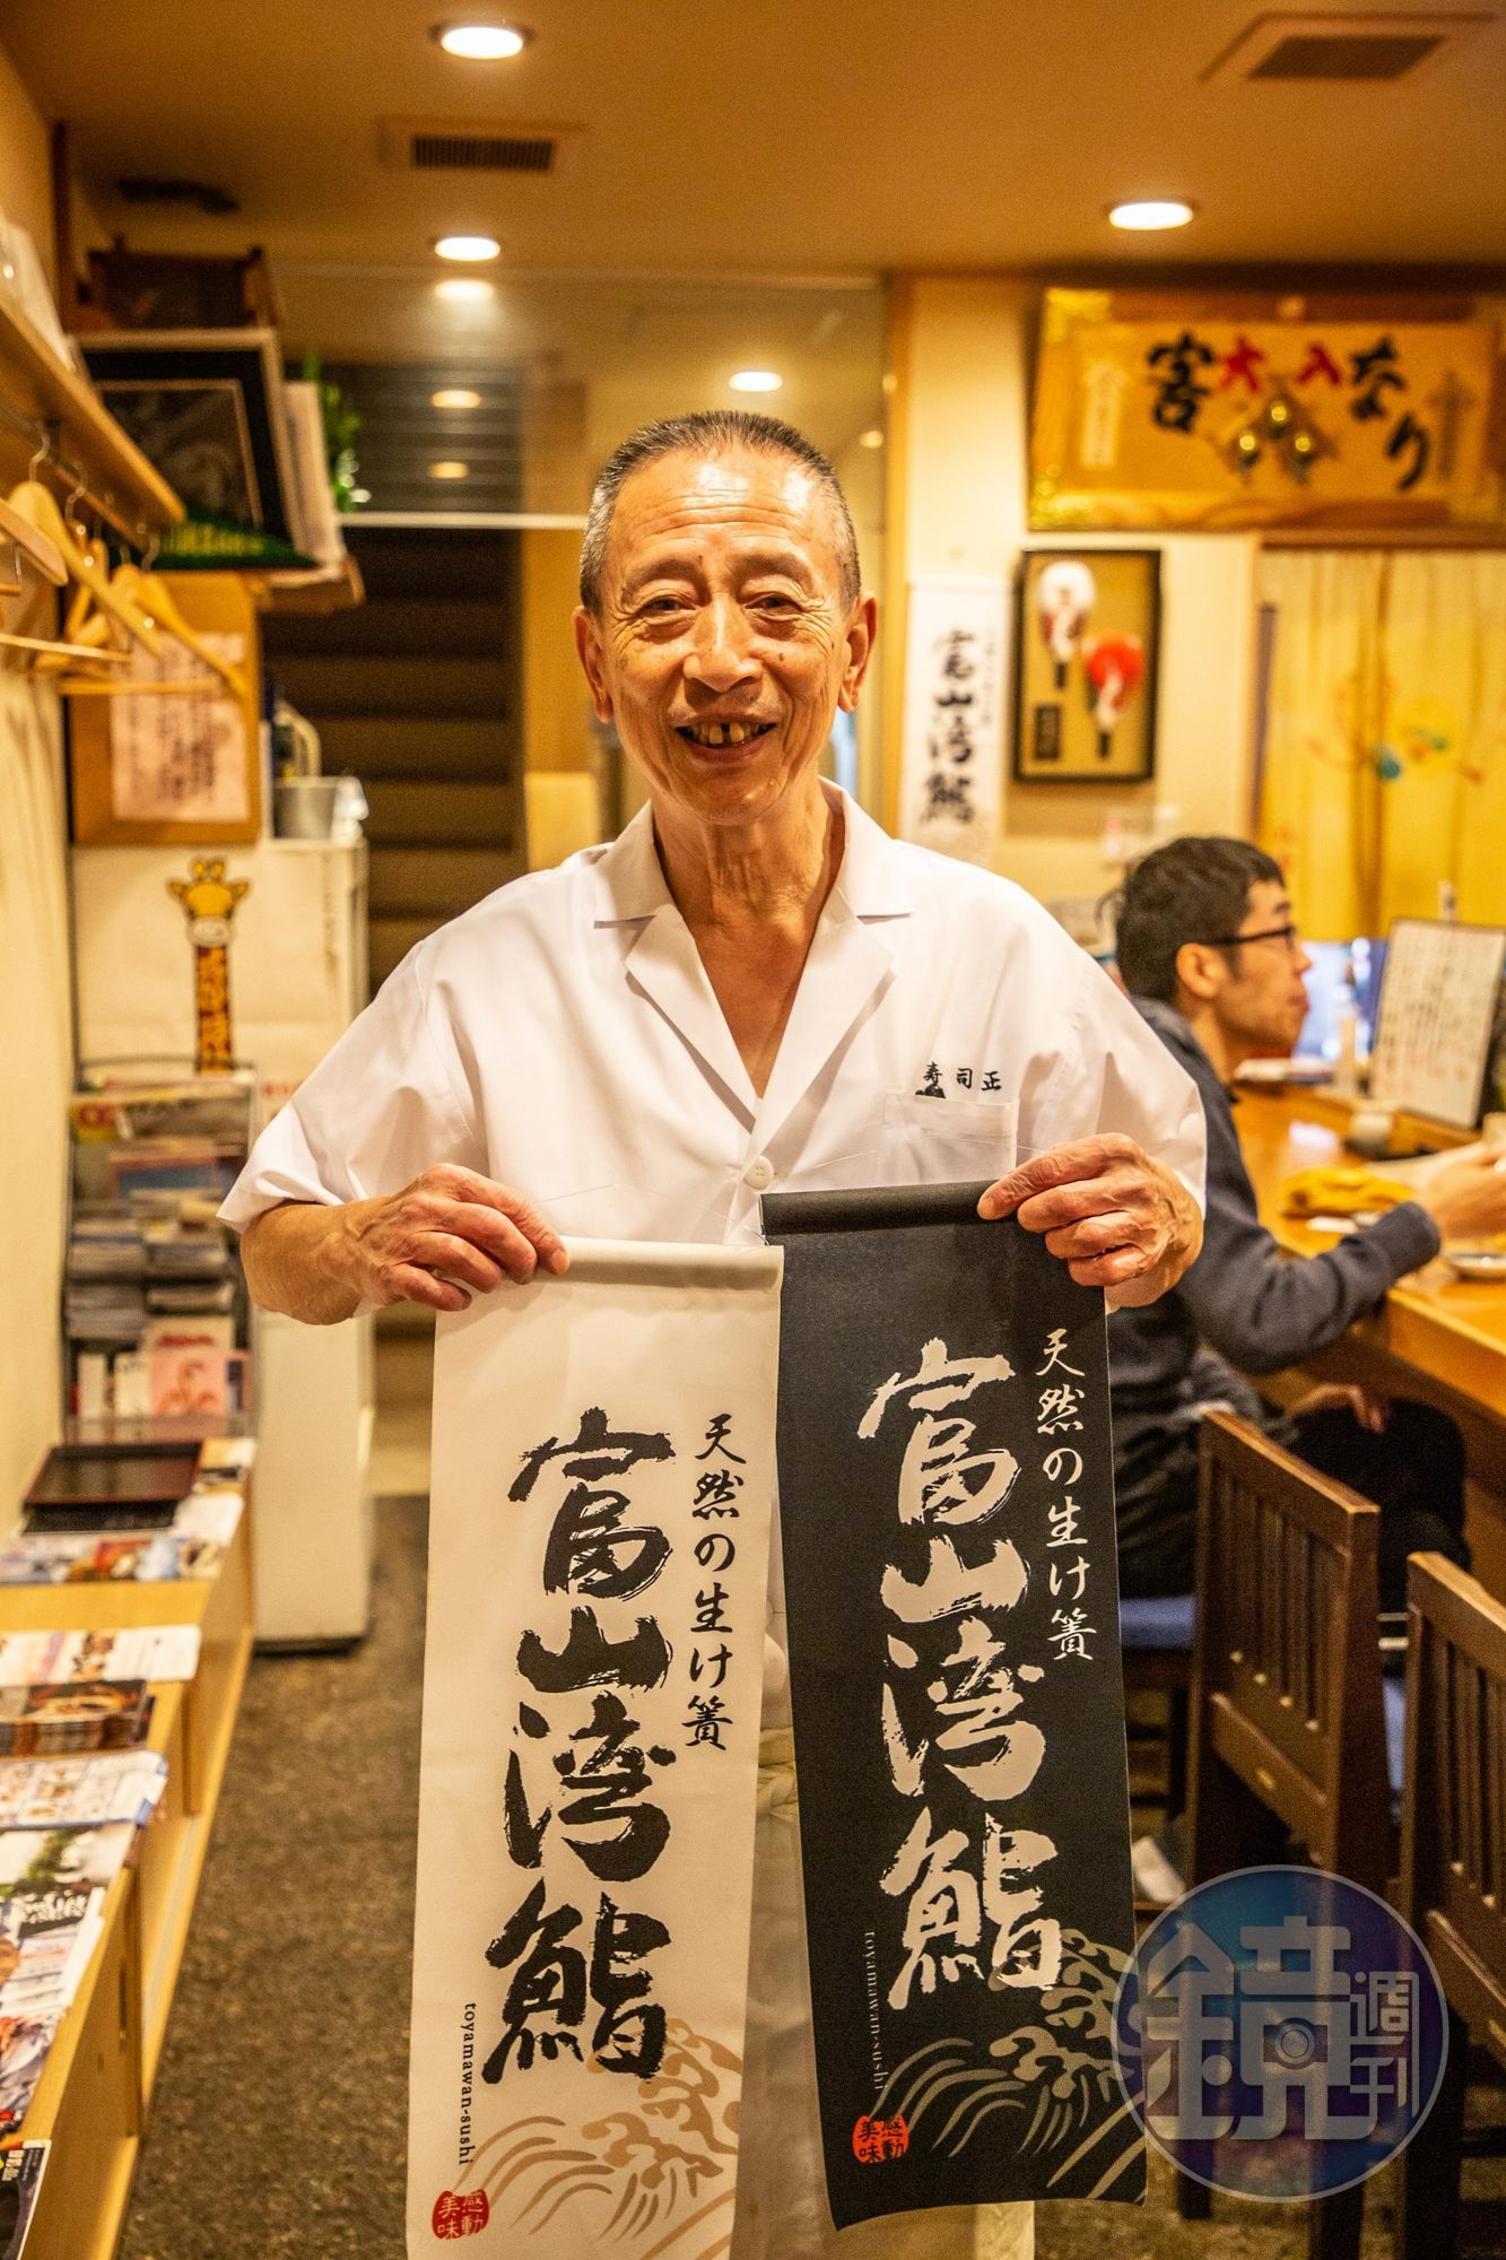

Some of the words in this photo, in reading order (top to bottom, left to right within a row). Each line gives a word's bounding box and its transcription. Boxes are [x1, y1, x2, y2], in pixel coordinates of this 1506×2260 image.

[681, 1412, 747, 1751] 天然の生け簀
[1034, 1328, 1098, 1663] 天然の生け簀
[482, 1405, 676, 2085] 富山湾鮨
[857, 1336, 1066, 2012] 富山湾鮨
[458, 2002, 477, 2166] toyamawan-sushi
[864, 1930, 890, 2090] toyamawan-sushi
